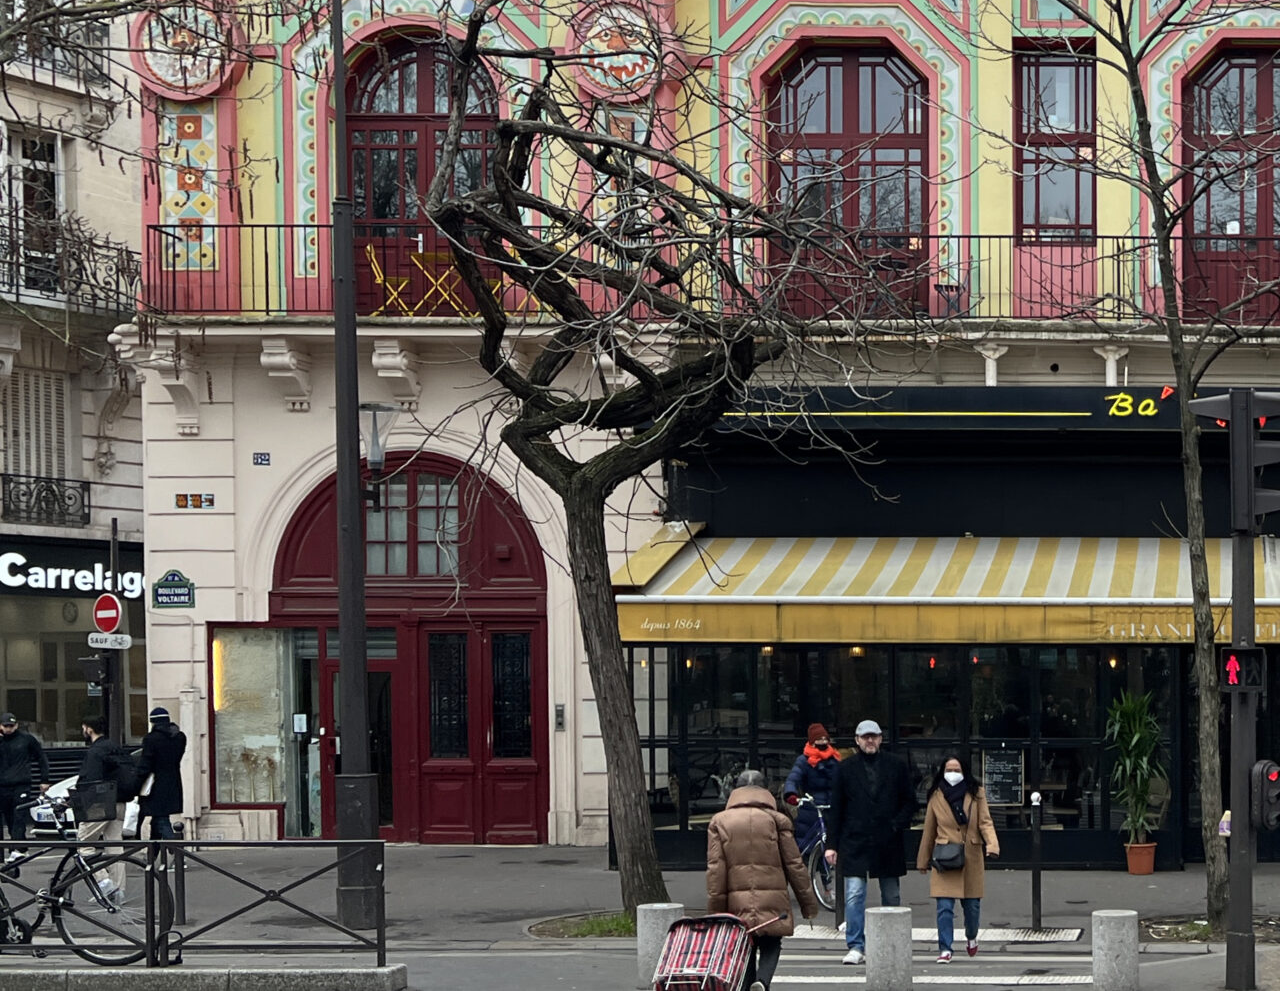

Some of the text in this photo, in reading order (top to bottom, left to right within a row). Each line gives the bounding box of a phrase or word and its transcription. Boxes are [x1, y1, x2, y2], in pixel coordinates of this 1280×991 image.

[0, 552, 146, 599] Carrelag
[157, 595, 189, 603] VOLTAIRE
[640, 617, 701, 632] depuis 1864
